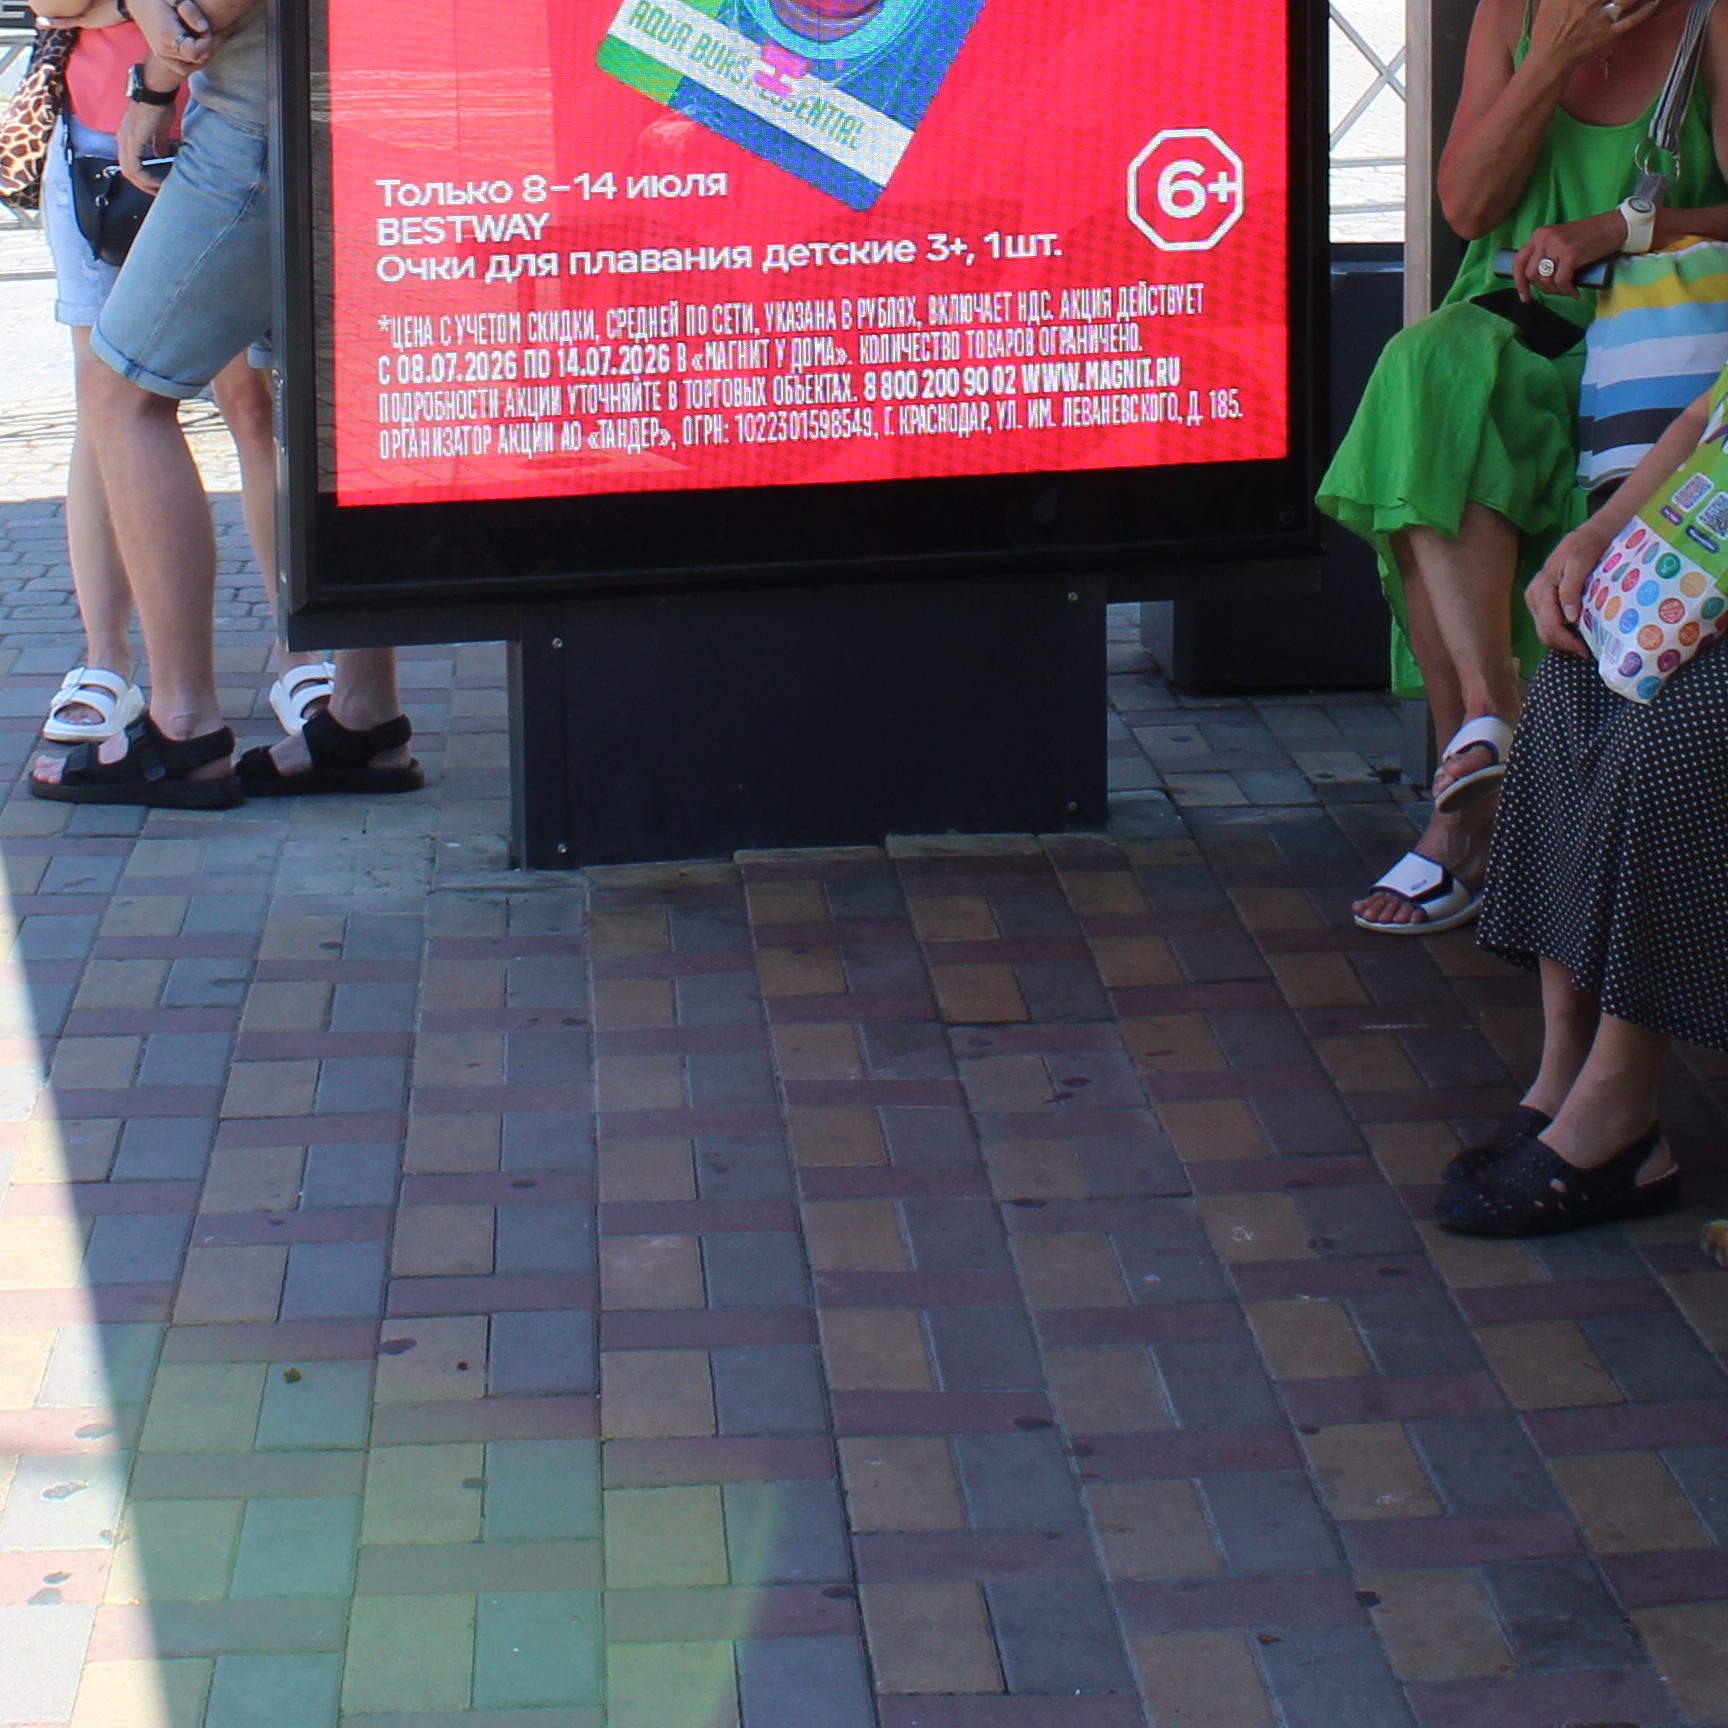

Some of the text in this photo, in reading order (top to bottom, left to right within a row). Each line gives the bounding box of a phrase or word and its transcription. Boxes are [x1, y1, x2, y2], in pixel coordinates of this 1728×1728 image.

[374, 178, 514, 208] Только
[626, 172, 729, 200] июля
[1155, 159, 1239, 219] 6+
[376, 213, 550, 247] BESTWAY
[377, 254, 476, 283] Очки
[483, 252, 559, 285] для
[569, 242, 753, 276] плавания
[761, 235, 916, 275] детские
[439, 315, 452, 346] С
[455, 311, 521, 346] УЧЕТОМ
[528, 308, 601, 347] СКИДКИ,
[606, 301, 679, 343] СРЕДНЕЙ
[685, 303, 709, 336] ПО
[712, 301, 761, 336] СЕТИ,
[763, 298, 838, 333] УКАЗАНА
[841, 298, 853, 330] В
[928, 291, 1013, 326] ВКЛЮЧАЕТ
[1059, 287, 1113, 323] АКЦИЯ
[1117, 281, 1205, 322] ДЕЙСТВУЕТ
[378, 354, 391, 384] С
[396, 350, 517, 385] 08.07.2026
[524, 348, 551, 379] ПО
[557, 342, 670, 378] 14.07.2026
[677, 342, 688, 372] В
[774, 337, 787, 368] У
[858, 330, 960, 365] КОЛИЧЕСТВО
[965, 327, 1035, 359] ТОВАРОВ
[1039, 322, 1143, 356] ОГРАНИЧЕНО.
[378, 387, 499, 427] ПОДРОБНОСТИ
[504, 385, 562, 421] АКЦИИ
[567, 375, 662, 415] УТОЧНЯЙТЕ
[668, 380, 679, 411] В
[682, 376, 768, 409] ТОРГОВЫХ
[863, 371, 877, 401] 8
[880, 369, 918, 400] 800
[920, 367, 960, 399] 200
[963, 365, 989, 396] 90
[992, 364, 1017, 394] 02
[1021, 355, 1181, 394] WWW.MAGNIT.RU
[379, 423, 492, 459] ОРГАНИЗАТОР
[498, 421, 556, 459] АКЦИИ
[561, 420, 582, 451] АО
[899, 400, 993, 439] КРАСНОДАР,
